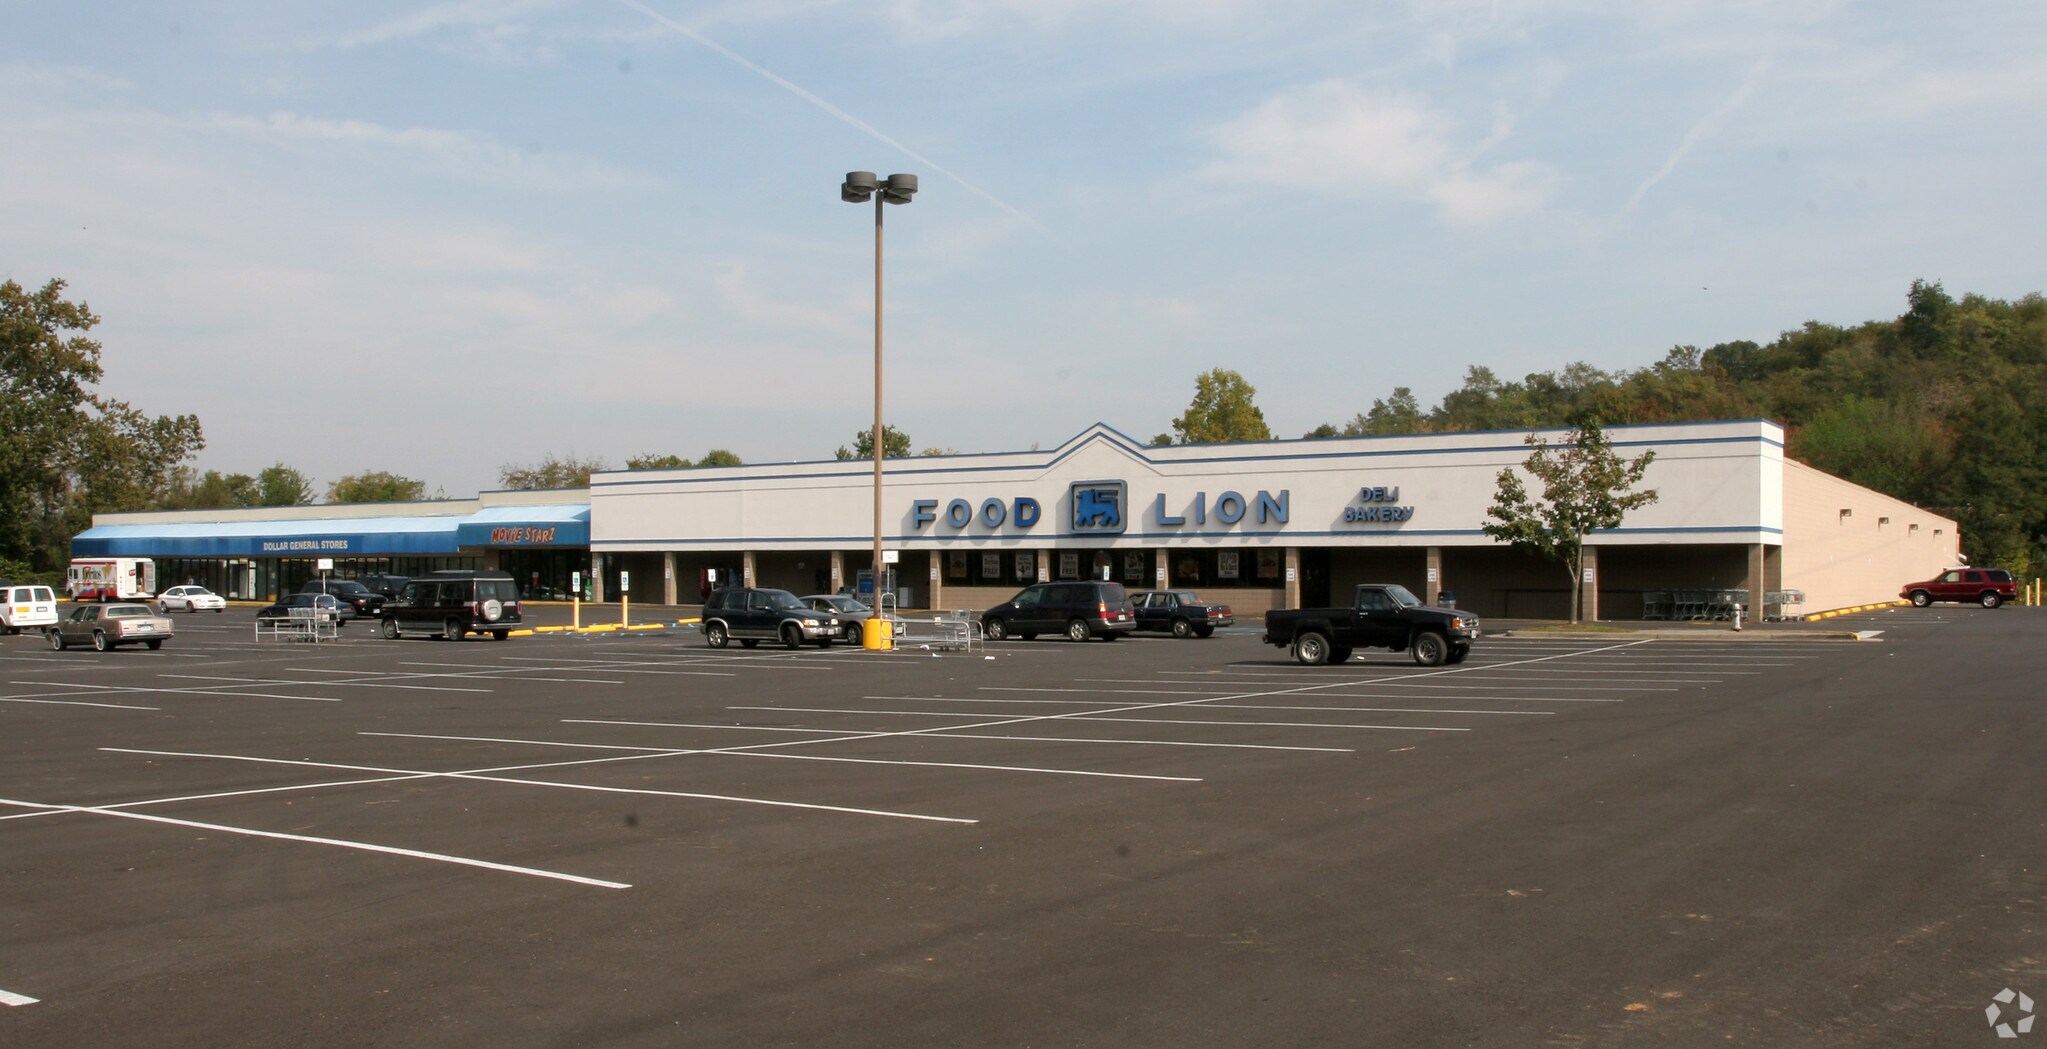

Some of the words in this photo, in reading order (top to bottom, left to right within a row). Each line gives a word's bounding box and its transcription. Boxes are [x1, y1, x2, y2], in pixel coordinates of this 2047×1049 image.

[1360, 486, 1400, 502] DELI
[912, 496, 1041, 529] FOOD
[1156, 489, 1290, 526] LION
[1344, 505, 1414, 522] BAKERY
[525, 526, 556, 543] STARZ
[263, 542, 288, 551] DOLLAR
[289, 540, 320, 550] GENERAL
[321, 540, 349, 550] STORES
